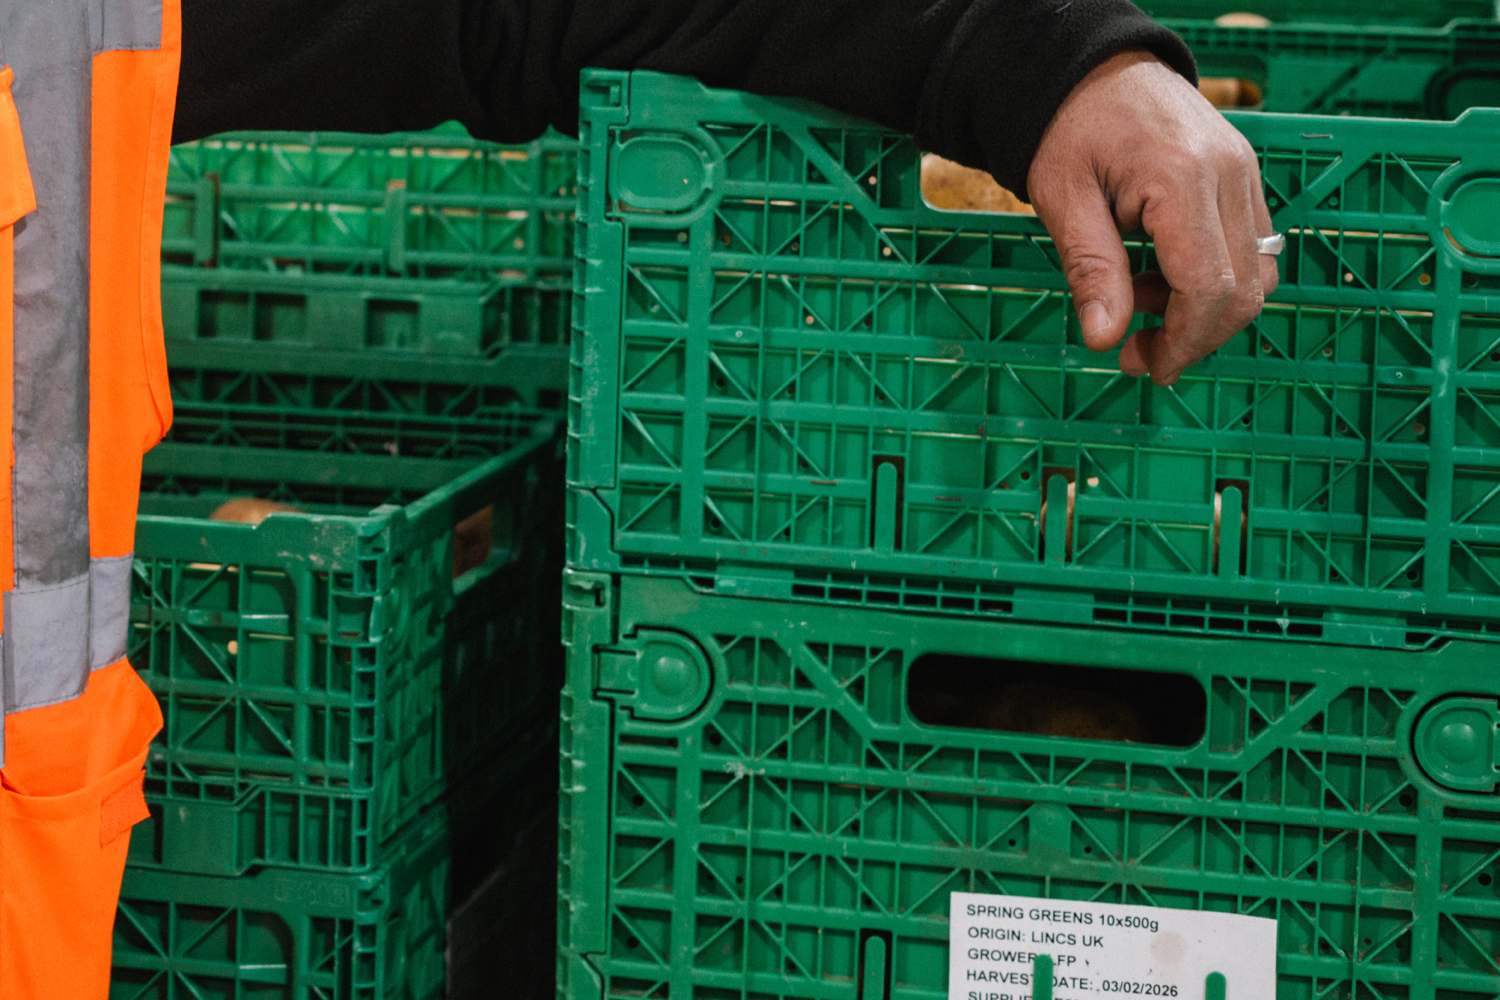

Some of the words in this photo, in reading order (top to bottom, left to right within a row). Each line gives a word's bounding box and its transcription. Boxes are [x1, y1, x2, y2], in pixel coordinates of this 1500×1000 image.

[967, 904, 1024, 919] SPRING
[1029, 909, 1093, 924] GREENS
[1099, 914, 1159, 932] 10x500g
[968, 927, 1025, 942] ORIGIN:
[1031, 931, 1077, 945] LINCS
[1083, 935, 1104, 947] UK
[1049, 954, 1077, 967] FP
[966, 970, 1033, 986] HARVES
[1102, 980, 1178, 997] 03/02/2026
